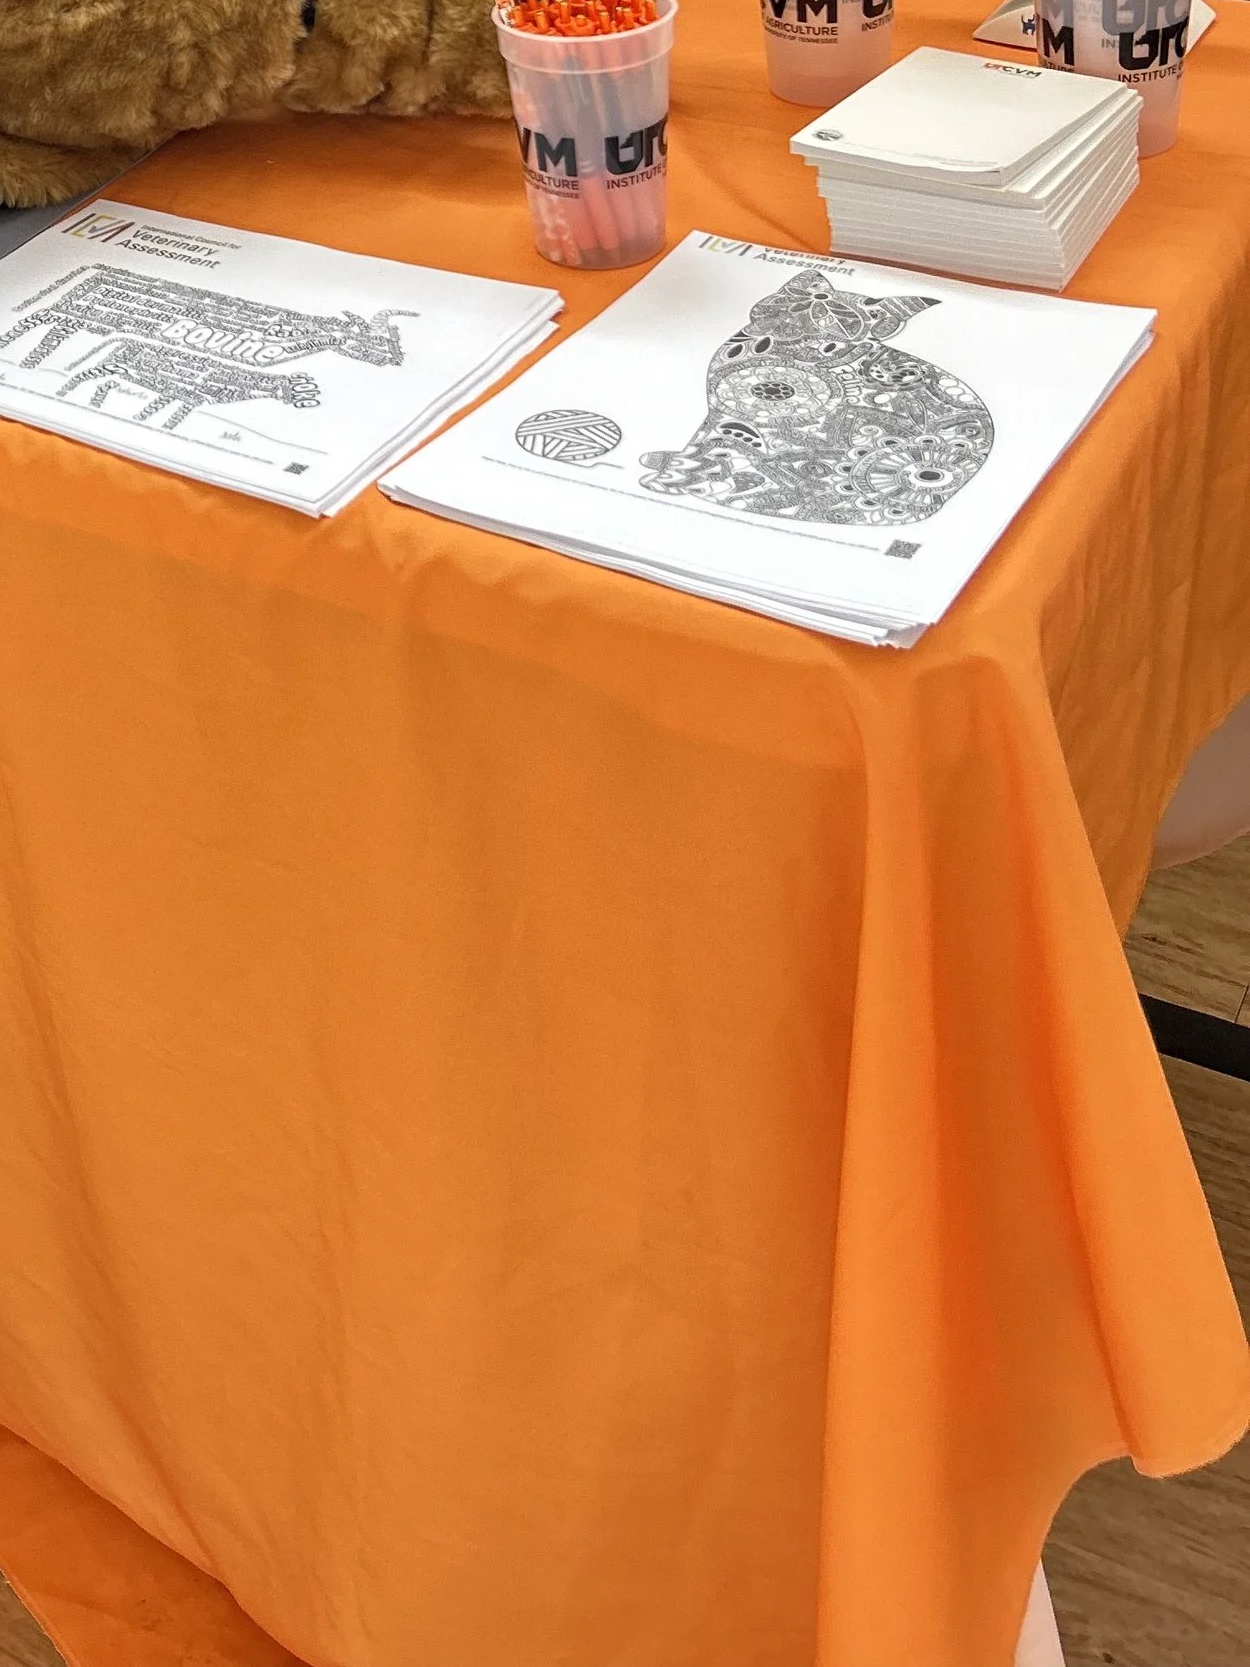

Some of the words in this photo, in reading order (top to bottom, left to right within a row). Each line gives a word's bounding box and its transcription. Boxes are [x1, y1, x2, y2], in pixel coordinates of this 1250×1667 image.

[1118, 64, 1177, 84] INSTITUTE
[606, 163, 662, 190] INSTITUTE
[115, 238, 222, 270] Assessment
[132, 230, 220, 257] Veterinary
[195, 235, 227, 248] Council
[228, 240, 242, 250] for
[753, 252, 857, 276] Assessment
[160, 318, 285, 363] Bovine
